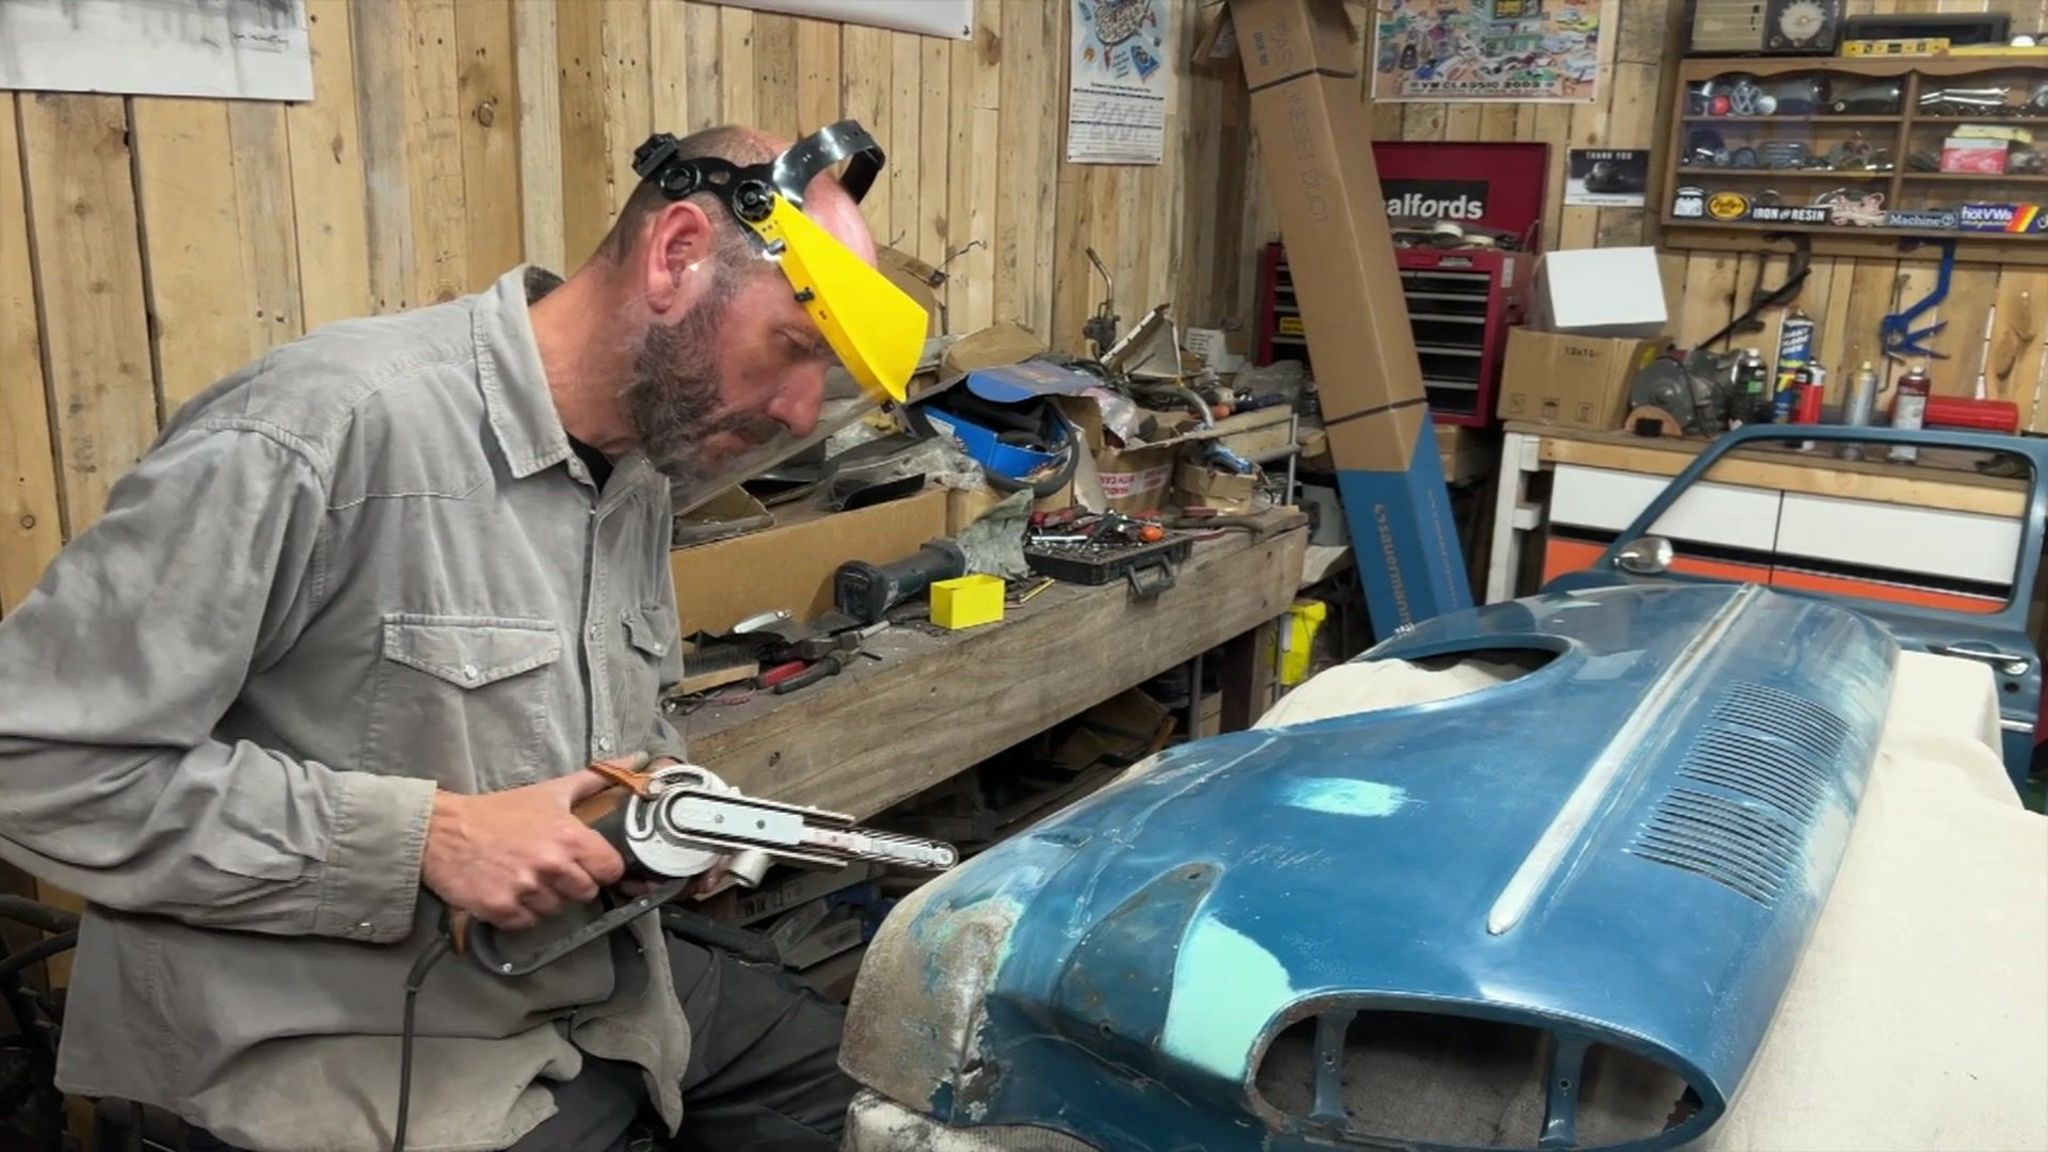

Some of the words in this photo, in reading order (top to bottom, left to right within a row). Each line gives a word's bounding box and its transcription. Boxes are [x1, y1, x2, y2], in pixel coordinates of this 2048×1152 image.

[1586, 151, 1613, 160] THANK
[1615, 152, 1633, 160] YOU
[1386, 193, 1484, 220] alfords
[1752, 207, 1779, 220] IRON
[1790, 208, 1826, 221] RESIN
[1889, 213, 1941, 226] Machine
[1378, 523, 1414, 626] sauermann
